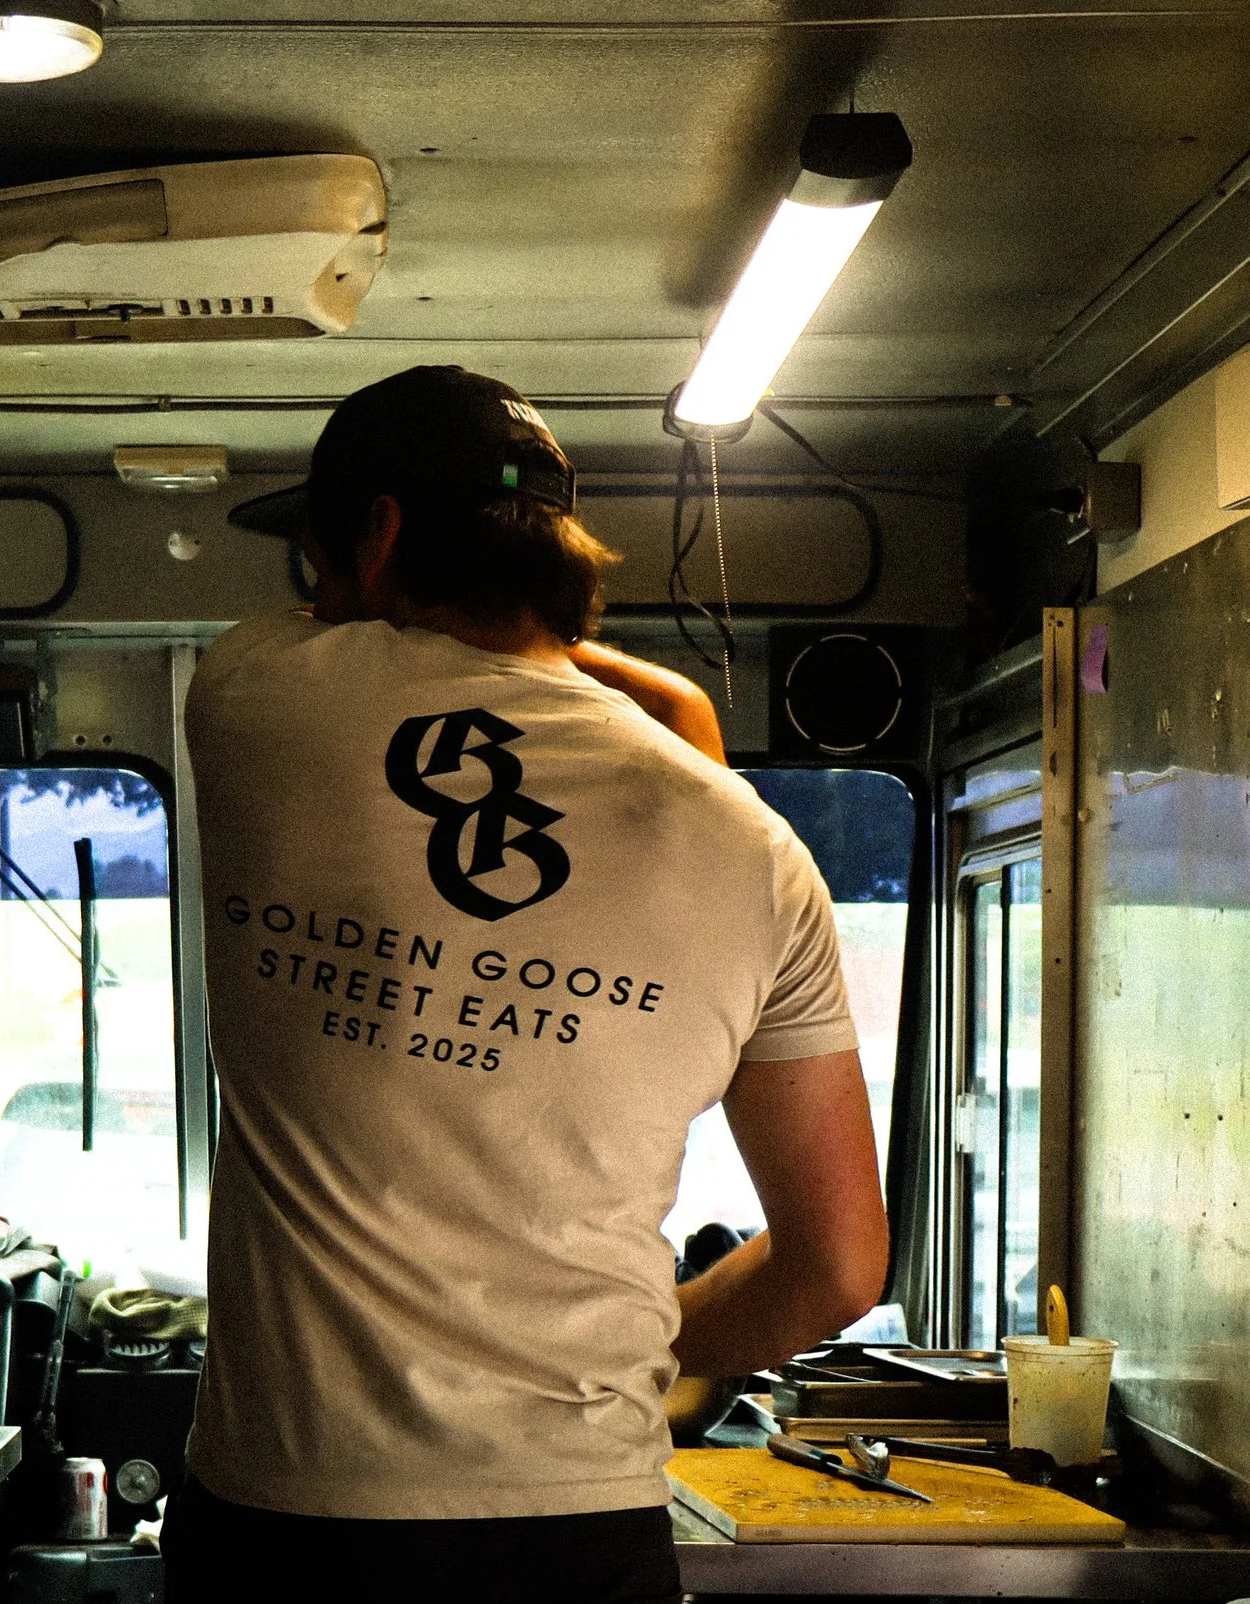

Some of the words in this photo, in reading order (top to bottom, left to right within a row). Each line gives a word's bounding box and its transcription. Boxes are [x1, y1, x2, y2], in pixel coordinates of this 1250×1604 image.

[224, 895, 443, 970] GOLDEN
[472, 950, 664, 1013] GOOSE
[258, 949, 433, 1017] STREET
[458, 995, 581, 1044] EATS
[323, 1011, 387, 1050] EST.
[408, 1033, 501, 1072] 2025
